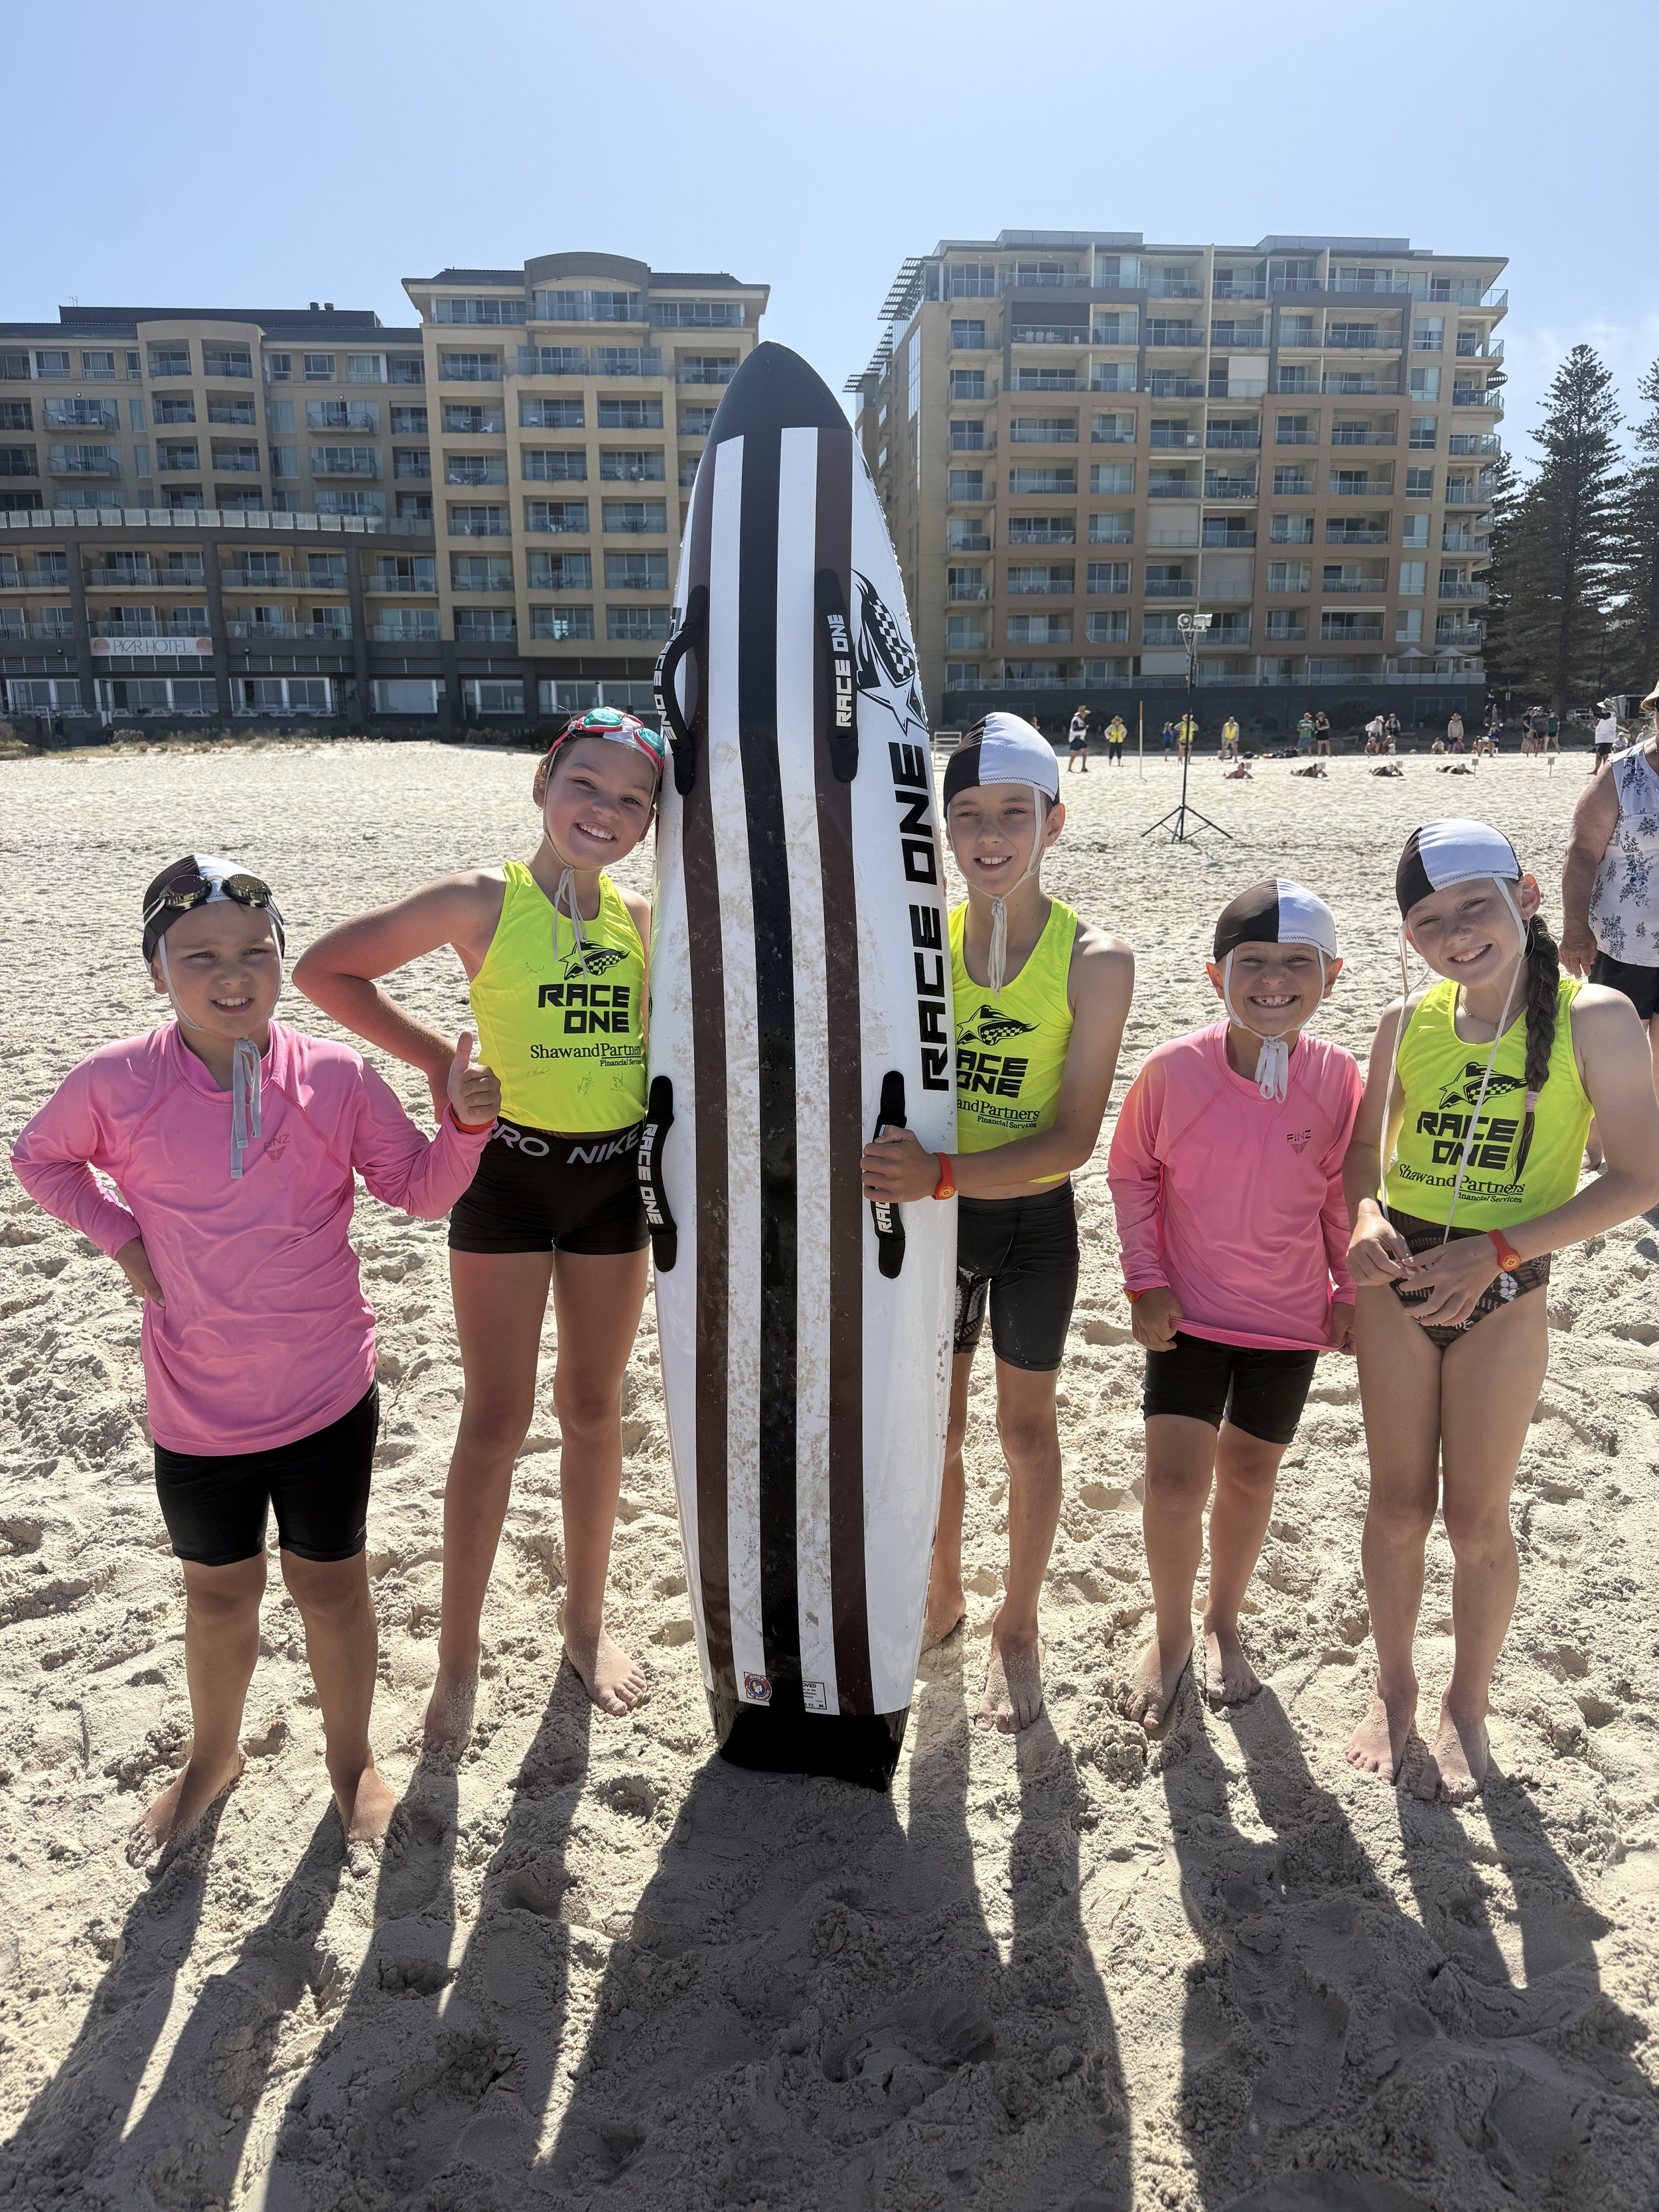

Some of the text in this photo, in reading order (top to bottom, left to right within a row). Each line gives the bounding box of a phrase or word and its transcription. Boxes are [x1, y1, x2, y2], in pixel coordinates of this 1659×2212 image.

[146, 639, 192, 654] HOTEL
[828, 615, 852, 727] RACE ONE
[654, 694, 678, 740] ONE
[889, 741, 950, 1092] RACE ONE
[538, 984, 630, 1009] RACE
[563, 1010, 630, 1034] ONE
[599, 1059, 628, 1067] Financial
[956, 1048, 1029, 1078] ACE
[956, 1070, 1023, 1098] ONE
[977, 1116, 1009, 1128] Financial
[1416, 1111, 1520, 1143] RACE
[263, 1133, 291, 1152] FNZ
[492, 1120, 640, 1164] RO NIKE
[1431, 1140, 1511, 1171] ONE
[638, 1124, 664, 1224] RACE ONE
